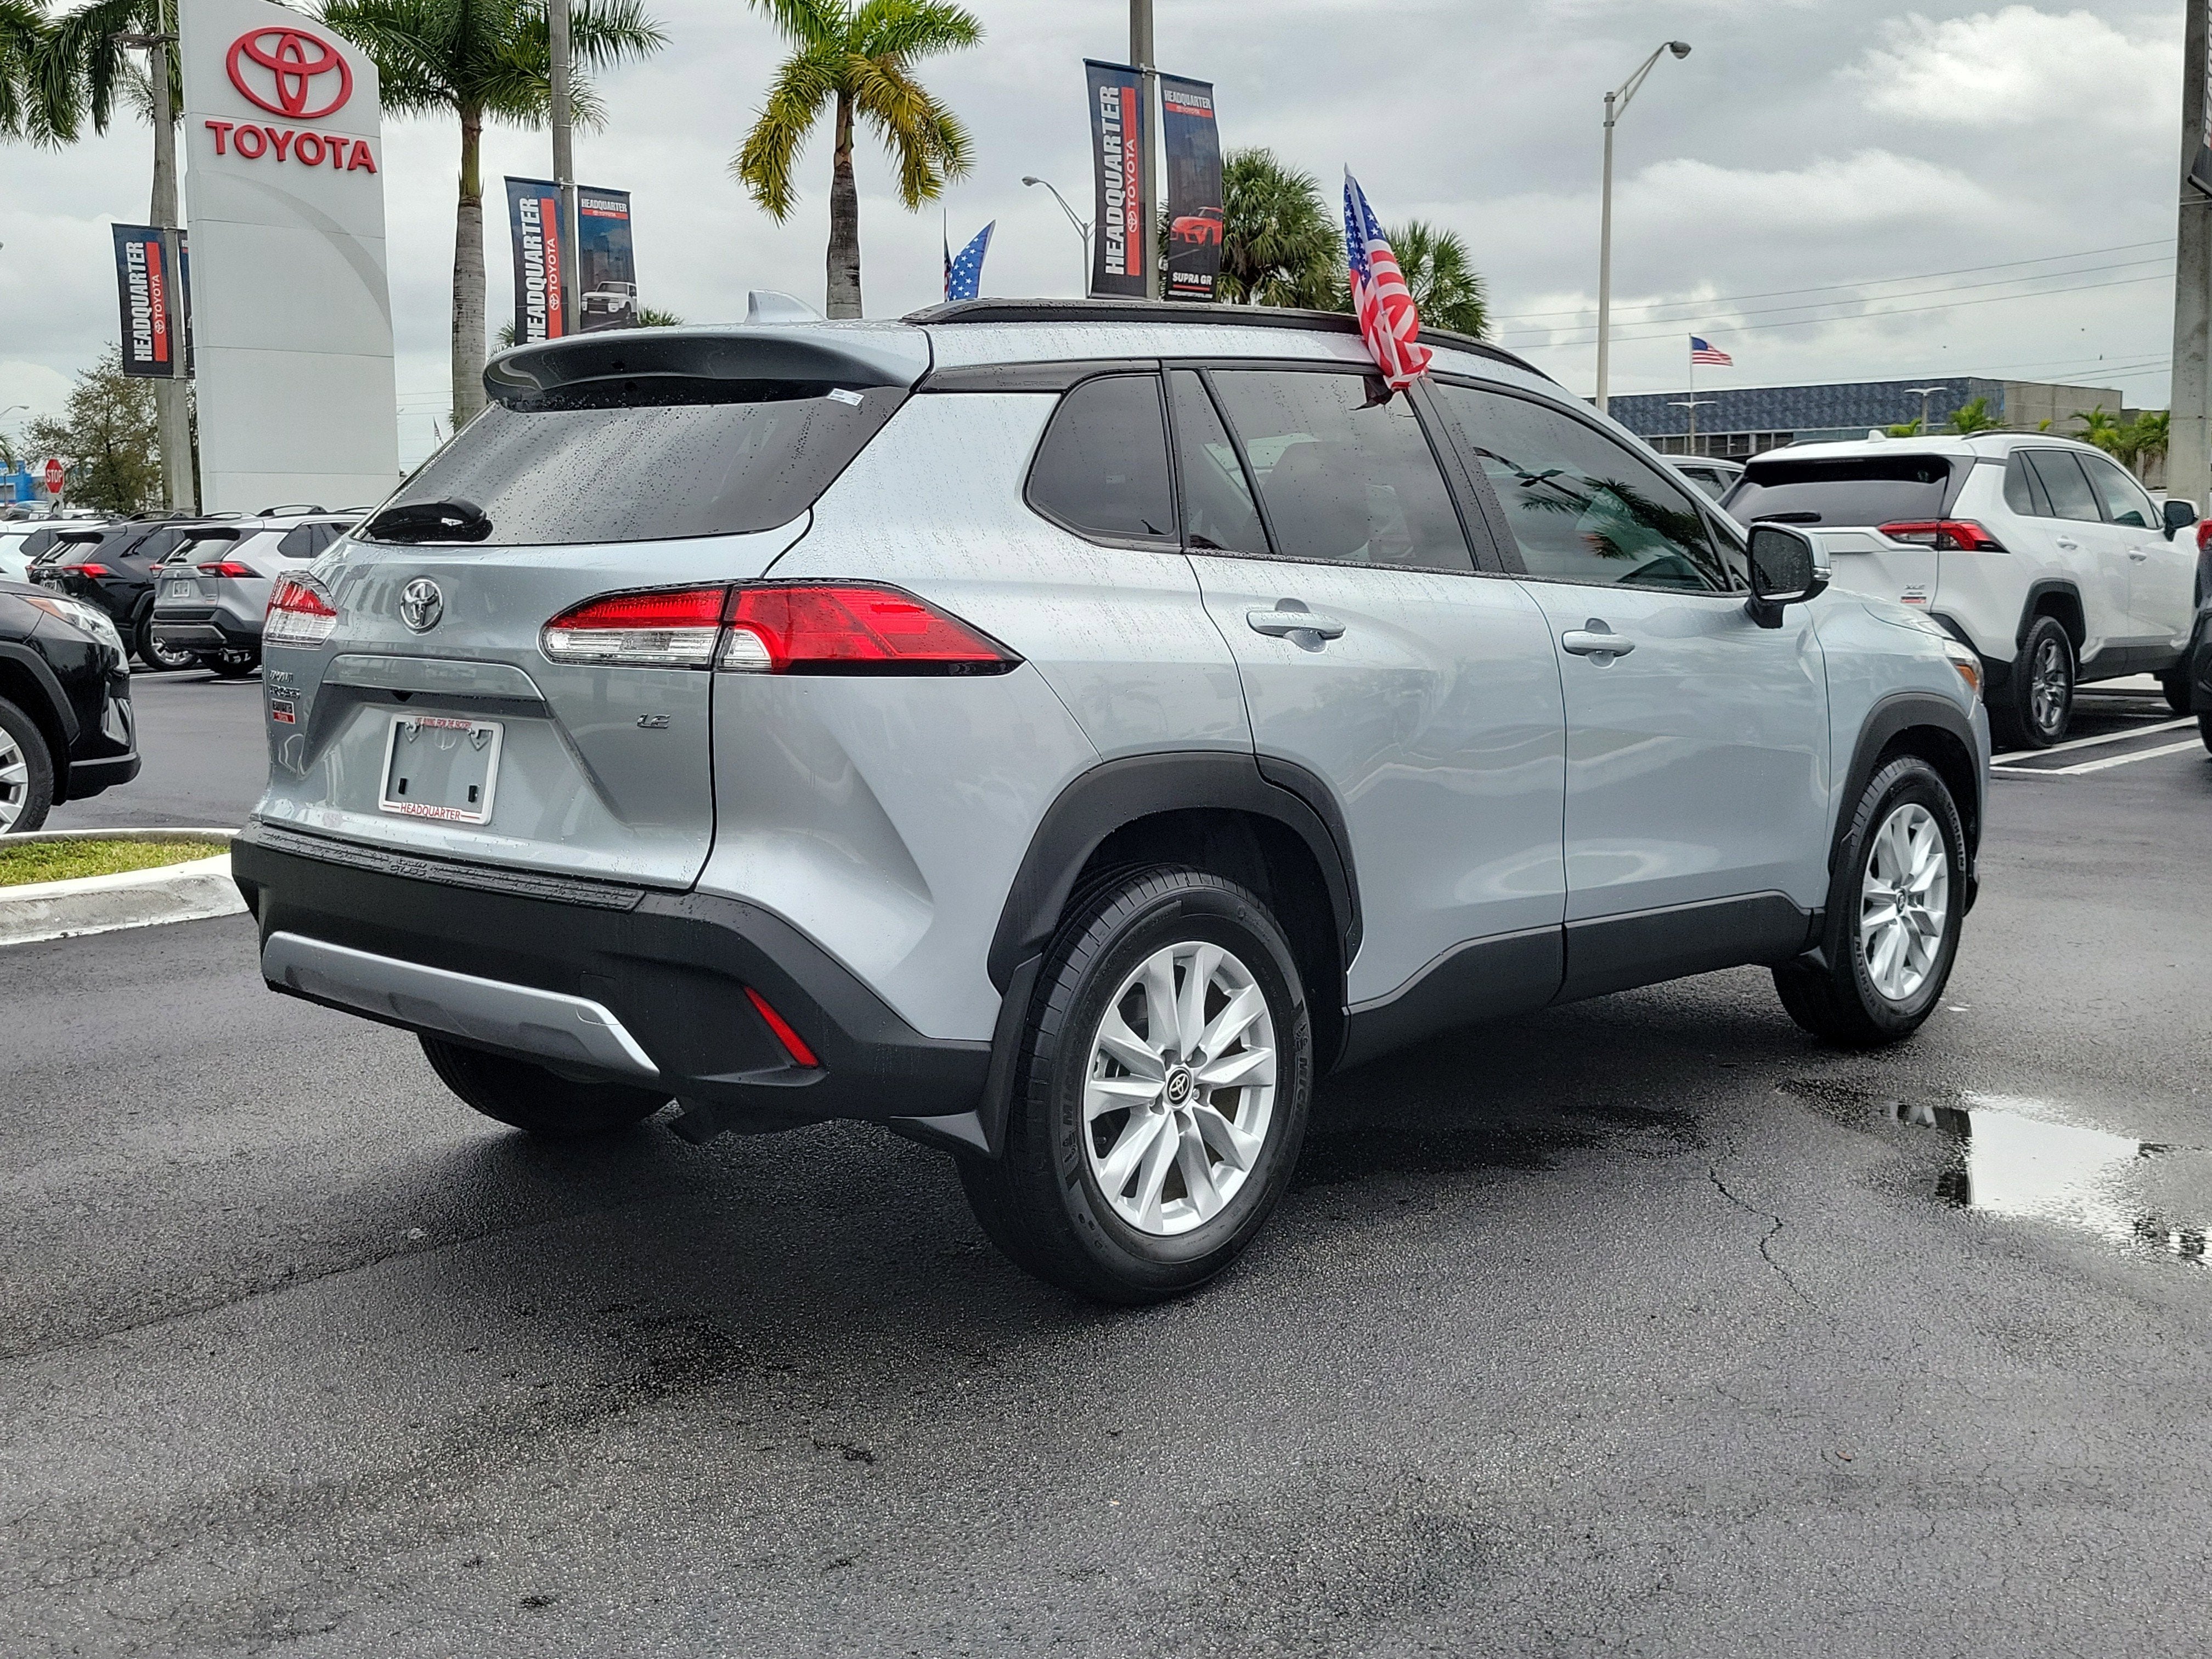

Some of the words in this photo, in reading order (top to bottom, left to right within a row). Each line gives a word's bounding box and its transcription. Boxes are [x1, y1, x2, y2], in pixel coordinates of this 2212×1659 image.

[1164, 89, 1211, 109] HEADQUARTER
[205, 120, 377, 173] TOYOTA
[1099, 86, 1125, 275] HEADQUARTER
[1127, 139, 1136, 207] TOYOTA
[582, 198, 627, 212] HEADQUARTER
[520, 198, 546, 343] HEADQUARTER
[548, 238, 558, 291] TOYOTA
[1172, 272, 1199, 284] SUPRA
[1200, 275, 1212, 285] GR
[126, 241, 153, 362] HEADQUARTER
[152, 275, 163, 318] TOYOTA
[47, 469, 63, 483] STOP
[637, 713, 671, 729] LE
[400, 803, 461, 820] HEADQUARTER
